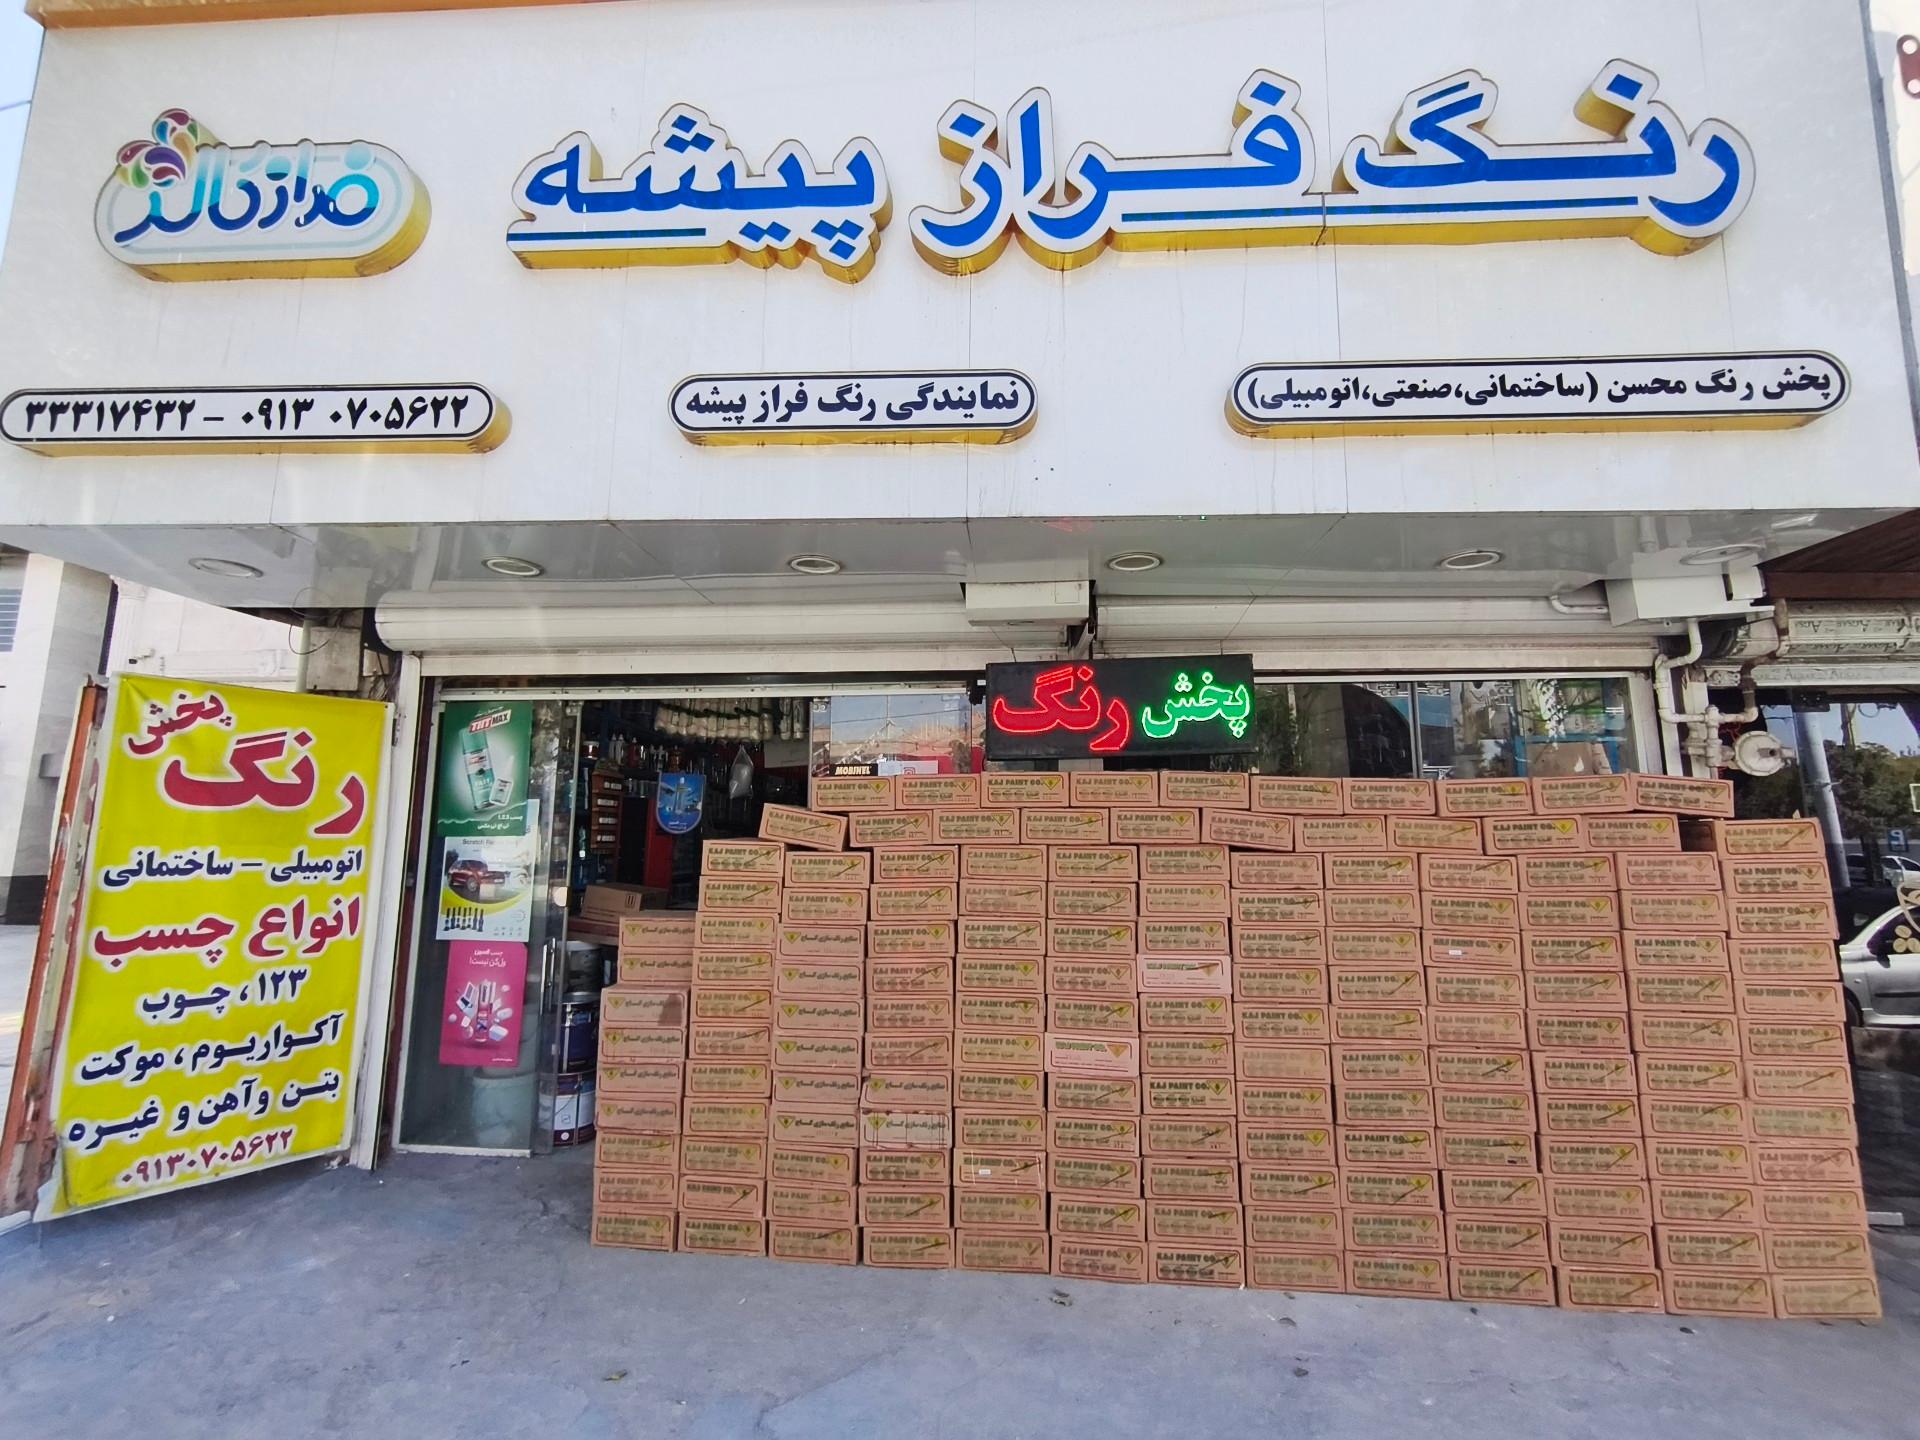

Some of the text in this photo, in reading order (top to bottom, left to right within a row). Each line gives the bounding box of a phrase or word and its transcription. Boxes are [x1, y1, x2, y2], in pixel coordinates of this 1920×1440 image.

[525, 68, 1740, 260] رنگ فراز پیشه
[1607, 374, 1687, 403] محسن
[1695, 368, 1754, 401] رنگ
[1763, 365, 1831, 400] پخش
[25, 397, 196, 432] ۳۳۳۱۷۴۳۲
[240, 397, 314, 431] ۰۹۱۳
[329, 396, 469, 430] ۰۷۰۵۶۲۲
[686, 380, 1019, 425] نمایندگی رنگ فراز پیشه
[127, 694, 232, 755] پخش
[993, 666, 1250, 751] پخش رنگ
[164, 730, 365, 834] رنگ
[103, 850, 233, 887] ساختمانی
[270, 849, 362, 882] اتومبیلی
[94, 896, 360, 968] انواع چسب
[142, 986, 231, 1020] چوب
[81, 1045, 164, 1082] موکت
[281, 1072, 340, 1108] بتن
[68, 1099, 159, 1150] غیره
[174, 1105, 190, 1131] و
[121, 1128, 293, 1183] ۰۹۱۳۰۷۰۵۶۲۲
